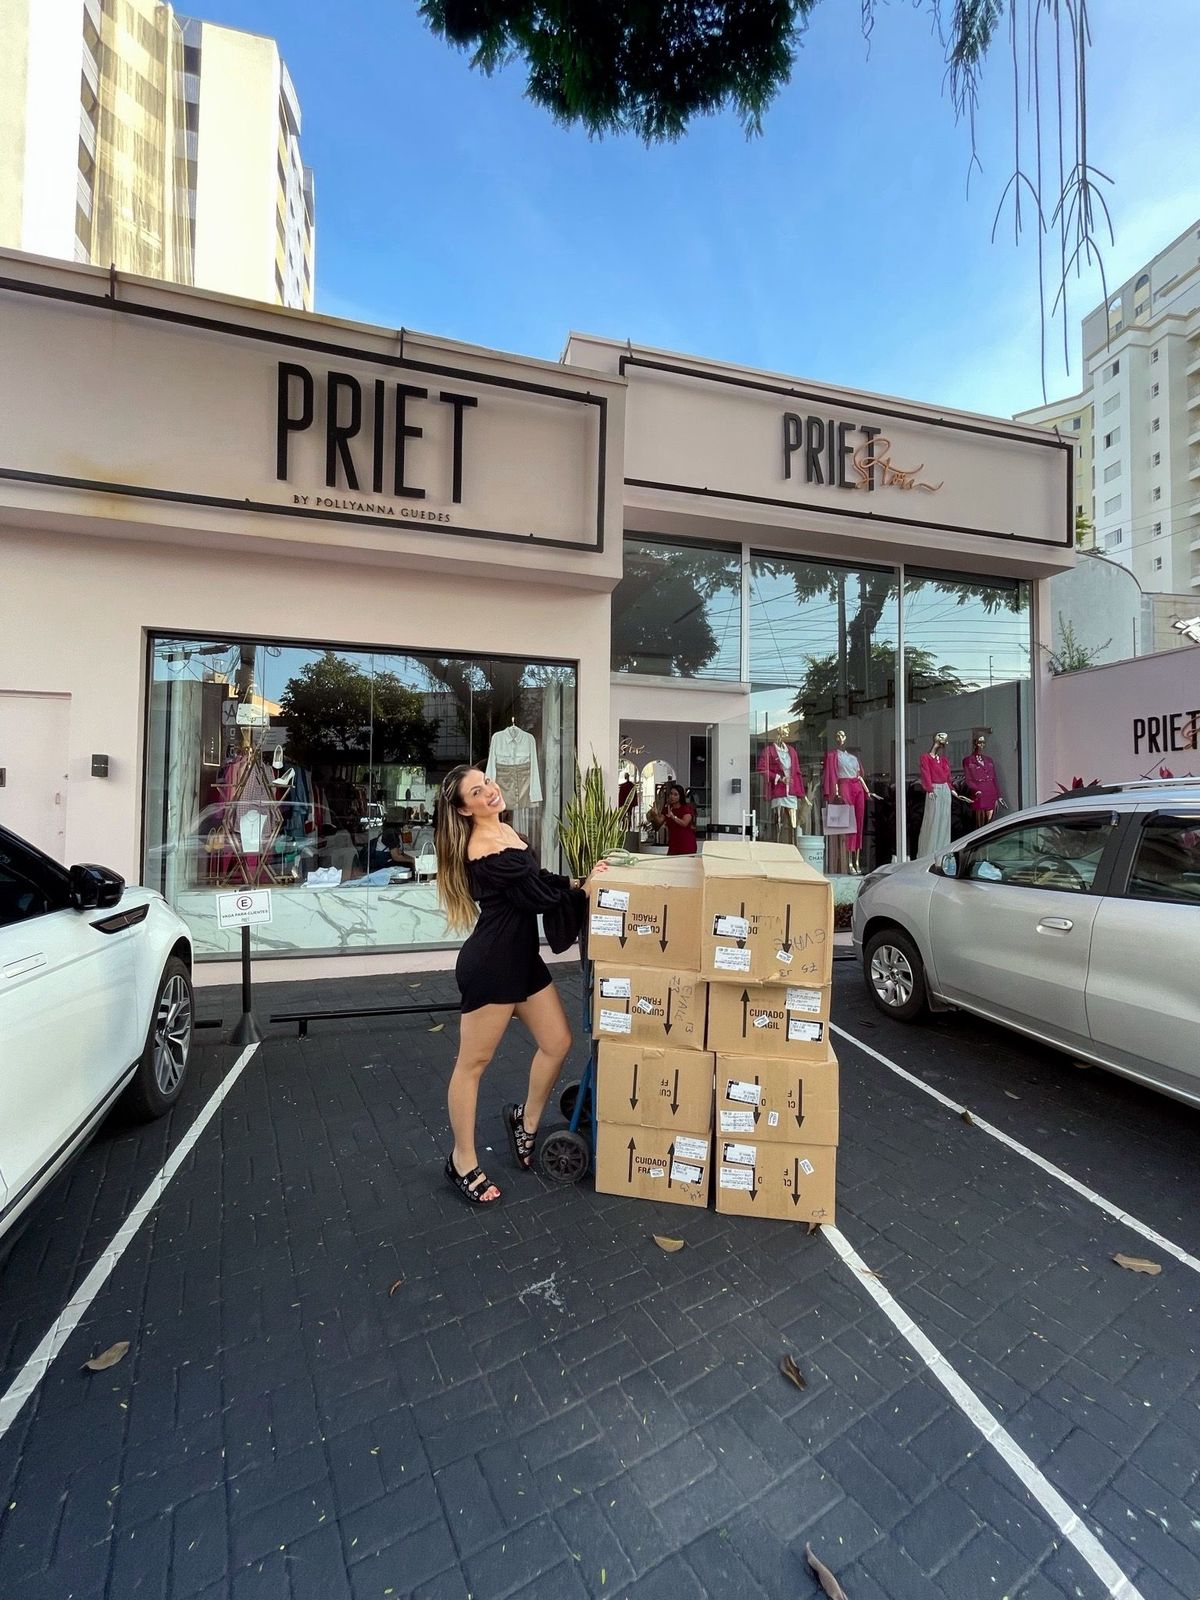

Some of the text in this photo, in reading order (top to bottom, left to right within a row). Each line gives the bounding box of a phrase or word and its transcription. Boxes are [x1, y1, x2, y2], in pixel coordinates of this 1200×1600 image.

[277, 361, 478, 503] PRIET
[784, 412, 881, 491] PRIET
[293, 494, 451, 522] BY POLLYANNA GUEDES
[1133, 710, 1200, 754] PRIET
[627, 923, 660, 934] CUDO
[635, 1156, 667, 1167] CUIDADO
